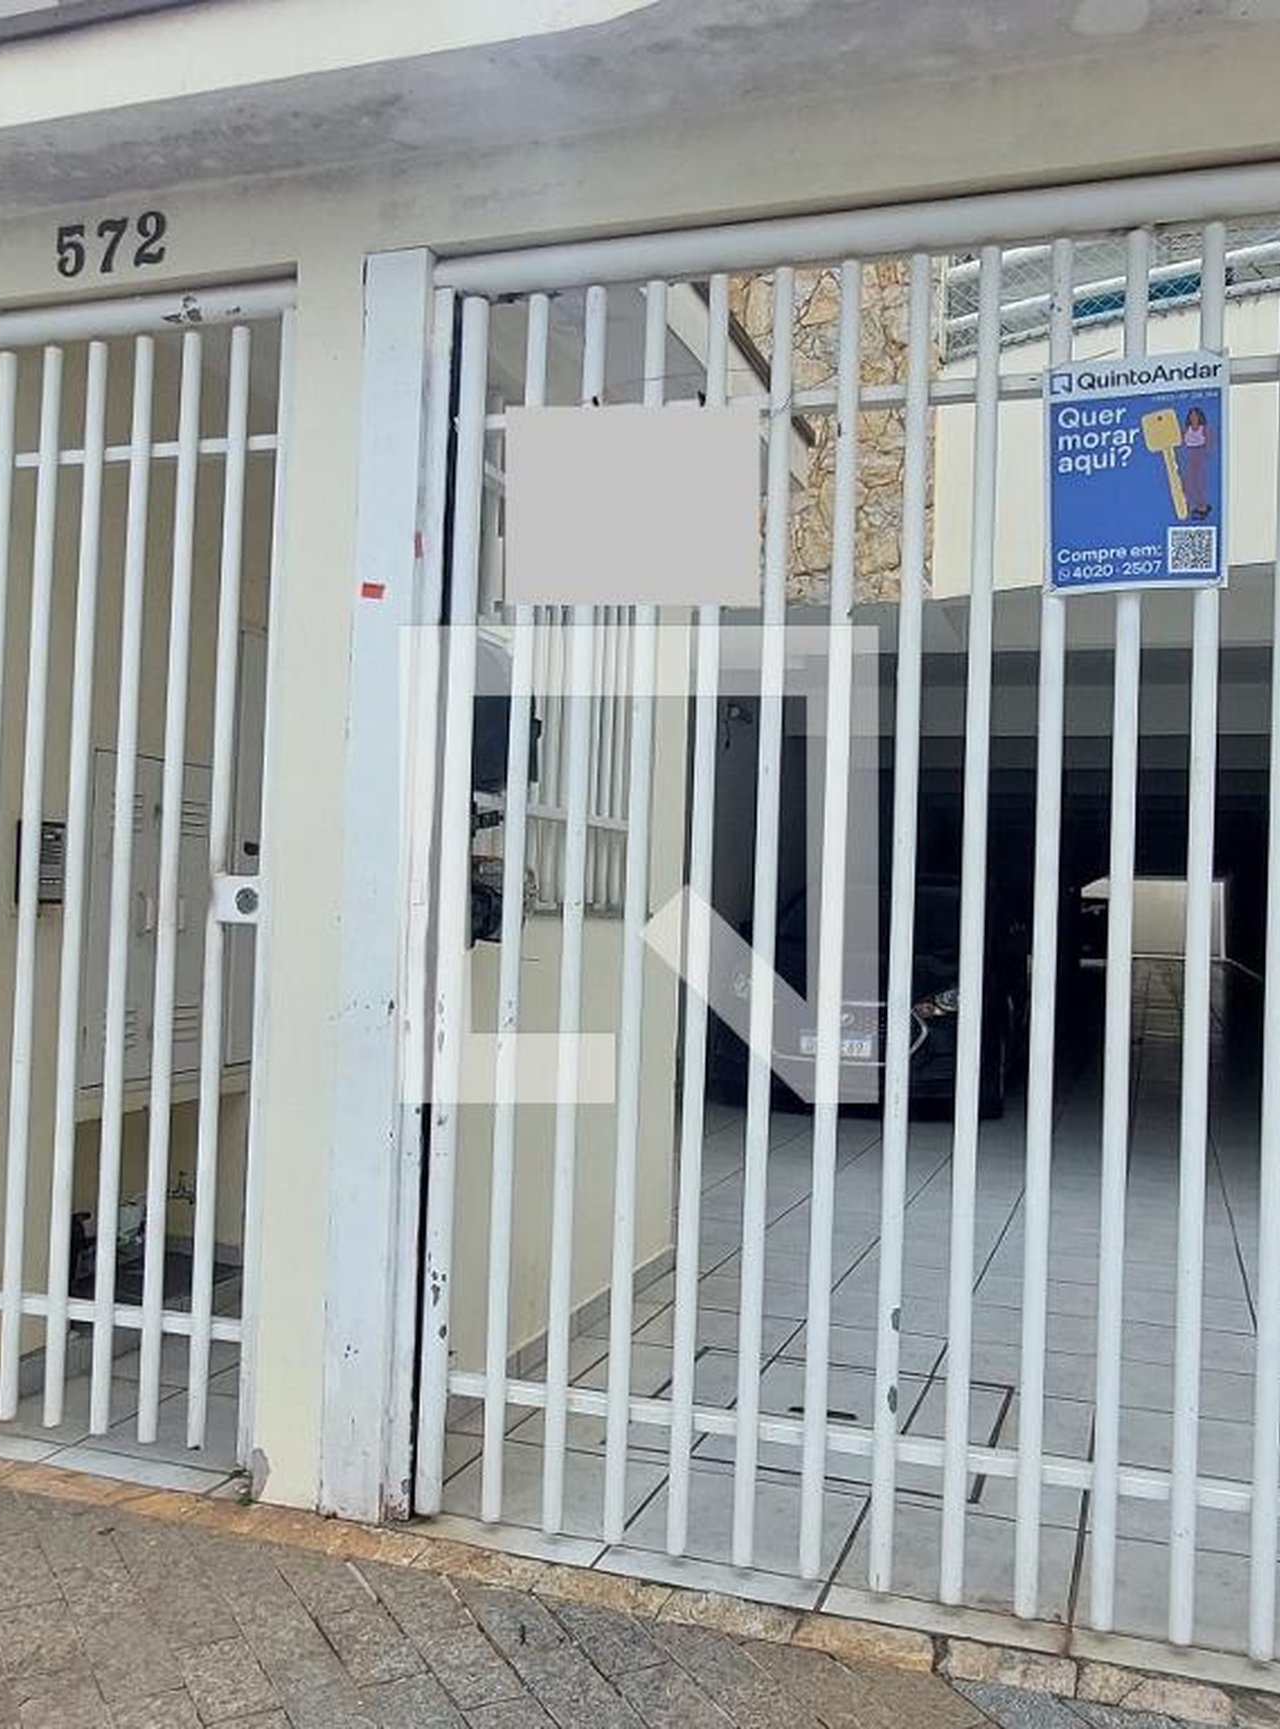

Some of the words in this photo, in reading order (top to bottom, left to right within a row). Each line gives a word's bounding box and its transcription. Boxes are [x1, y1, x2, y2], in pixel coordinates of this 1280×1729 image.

[57, 210, 167, 277] 572
[1077, 363, 1222, 390] QuintoAndar
[1058, 407, 1127, 428] Quer
[1058, 428, 1140, 450] morar
[1058, 446, 1132, 475] aqui?
[1057, 547, 1127, 564] Compre
[1072, 564, 1113, 579] 4020
[1122, 560, 1162, 575] 2507
